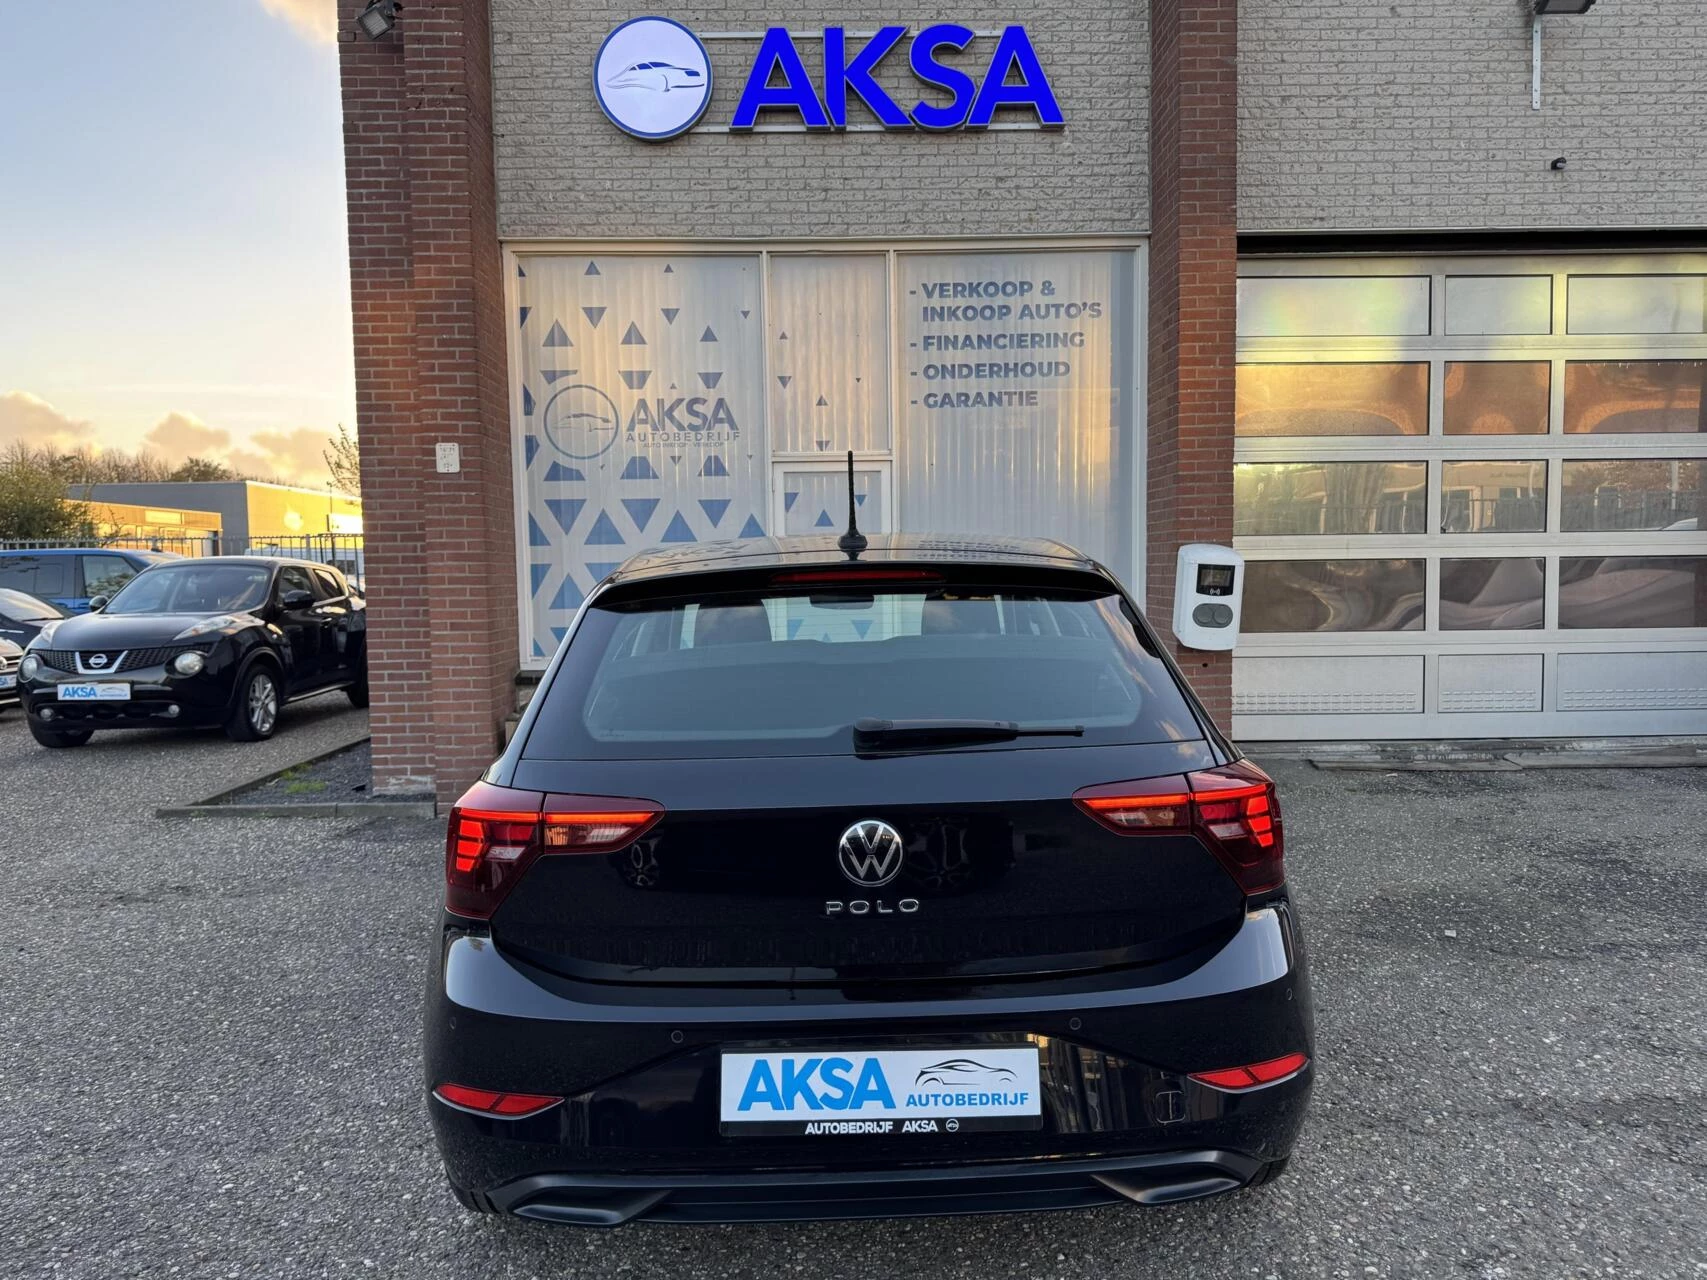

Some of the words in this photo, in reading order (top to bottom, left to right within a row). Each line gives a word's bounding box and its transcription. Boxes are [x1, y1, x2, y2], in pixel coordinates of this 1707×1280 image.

[729, 24, 1066, 132] AKSA
[922, 281, 1033, 299] VERKOOP
[1040, 280, 1055, 296] &
[922, 305, 1012, 322] INKOOP
[1018, 302, 1102, 320] AUTO'S
[923, 332, 1085, 351] FINANCIERING
[923, 361, 1071, 380] ONDERHOUD
[923, 390, 1038, 409] GARANTIE
[627, 398, 740, 432] AKSA
[625, 432, 741, 443] AUTOBEDRIJF
[62, 686, 97, 698] AKSA
[825, 898, 920, 915] POLO
[737, 1057, 896, 1112] AKSA
[905, 1091, 1029, 1108] AUTOBEDRIJF
[804, 1120, 893, 1135] AUTOBEDRIJF
[902, 1119, 938, 1133] AKSA
